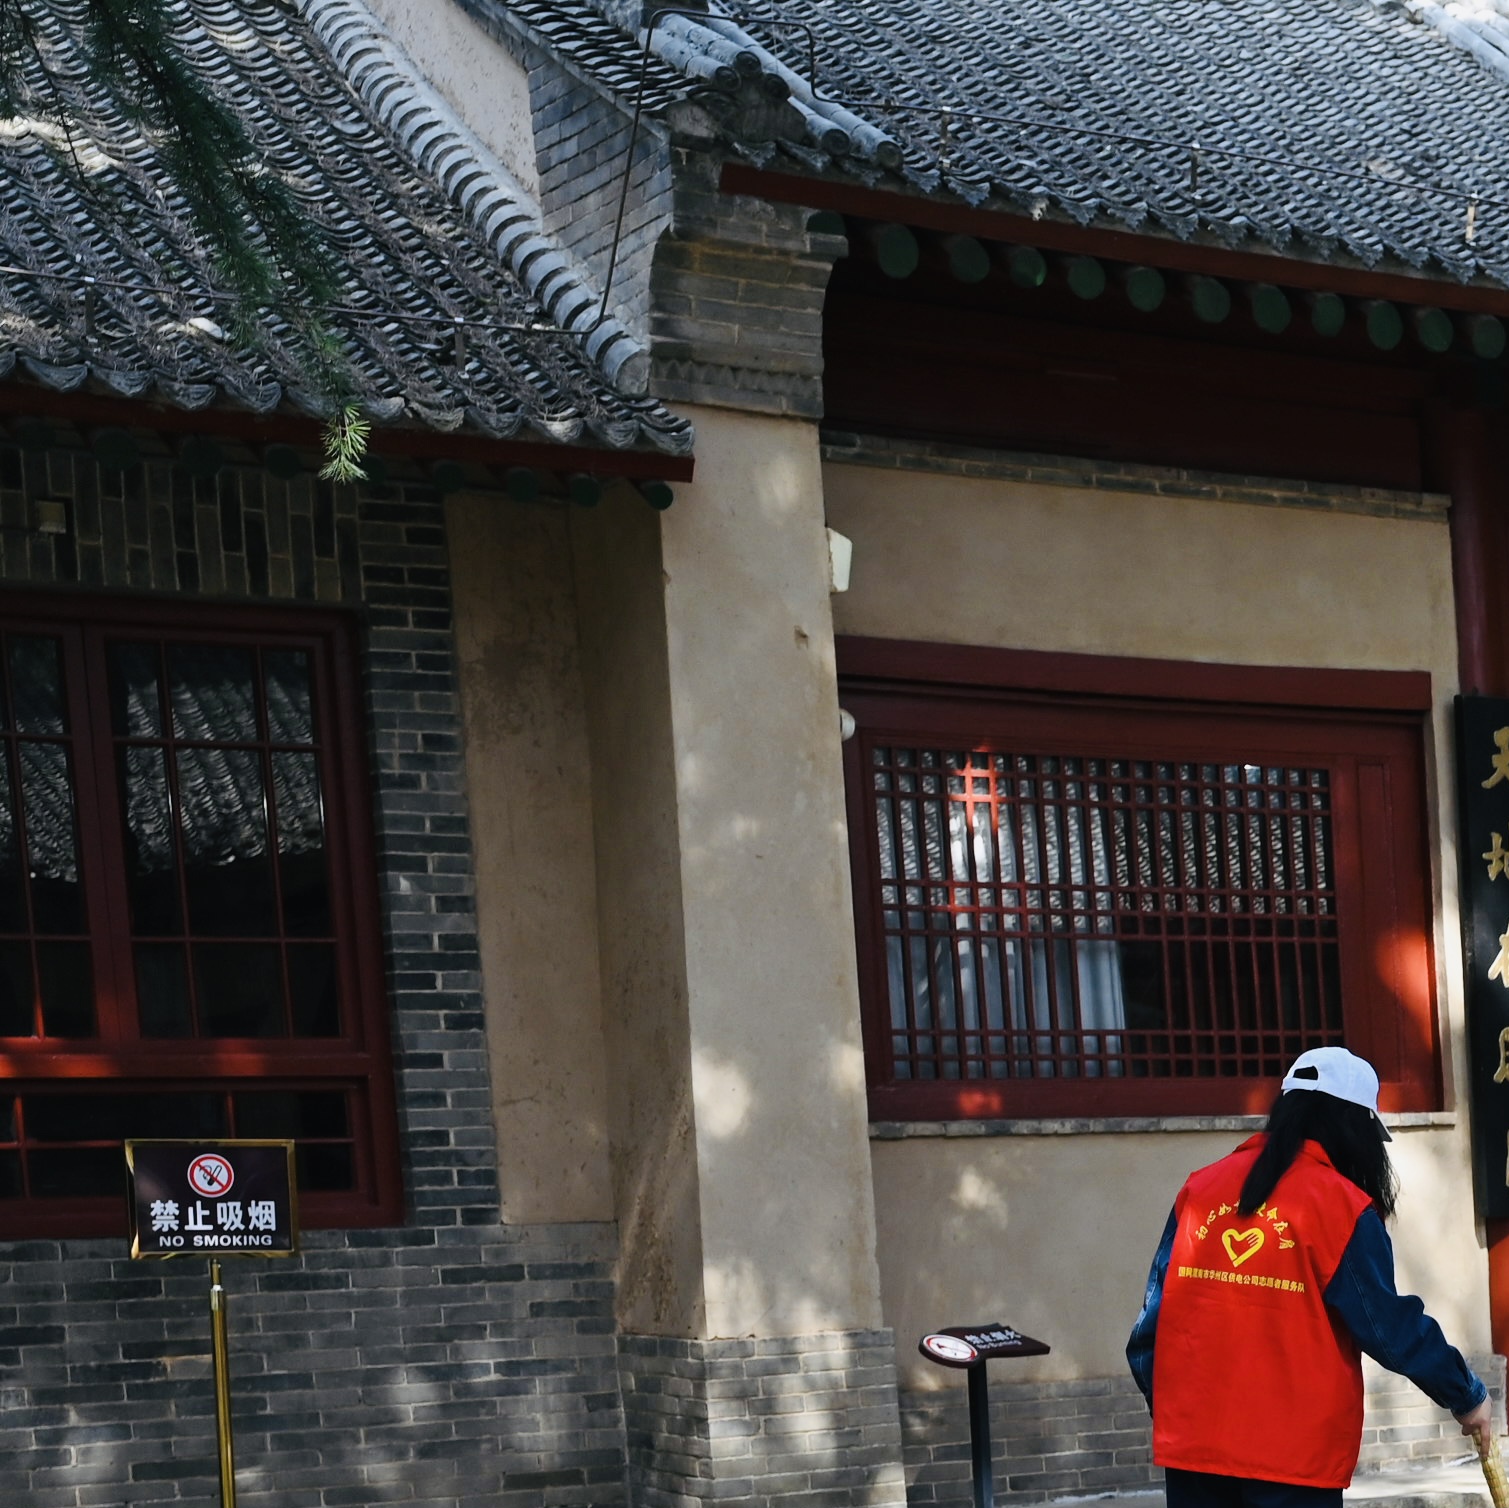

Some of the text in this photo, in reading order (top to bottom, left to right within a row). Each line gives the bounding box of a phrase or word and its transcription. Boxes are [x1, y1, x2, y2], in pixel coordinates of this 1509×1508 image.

[150, 1199, 276, 1232] 禁止吸烟
[159, 1234, 273, 1247] NO SMOKING
